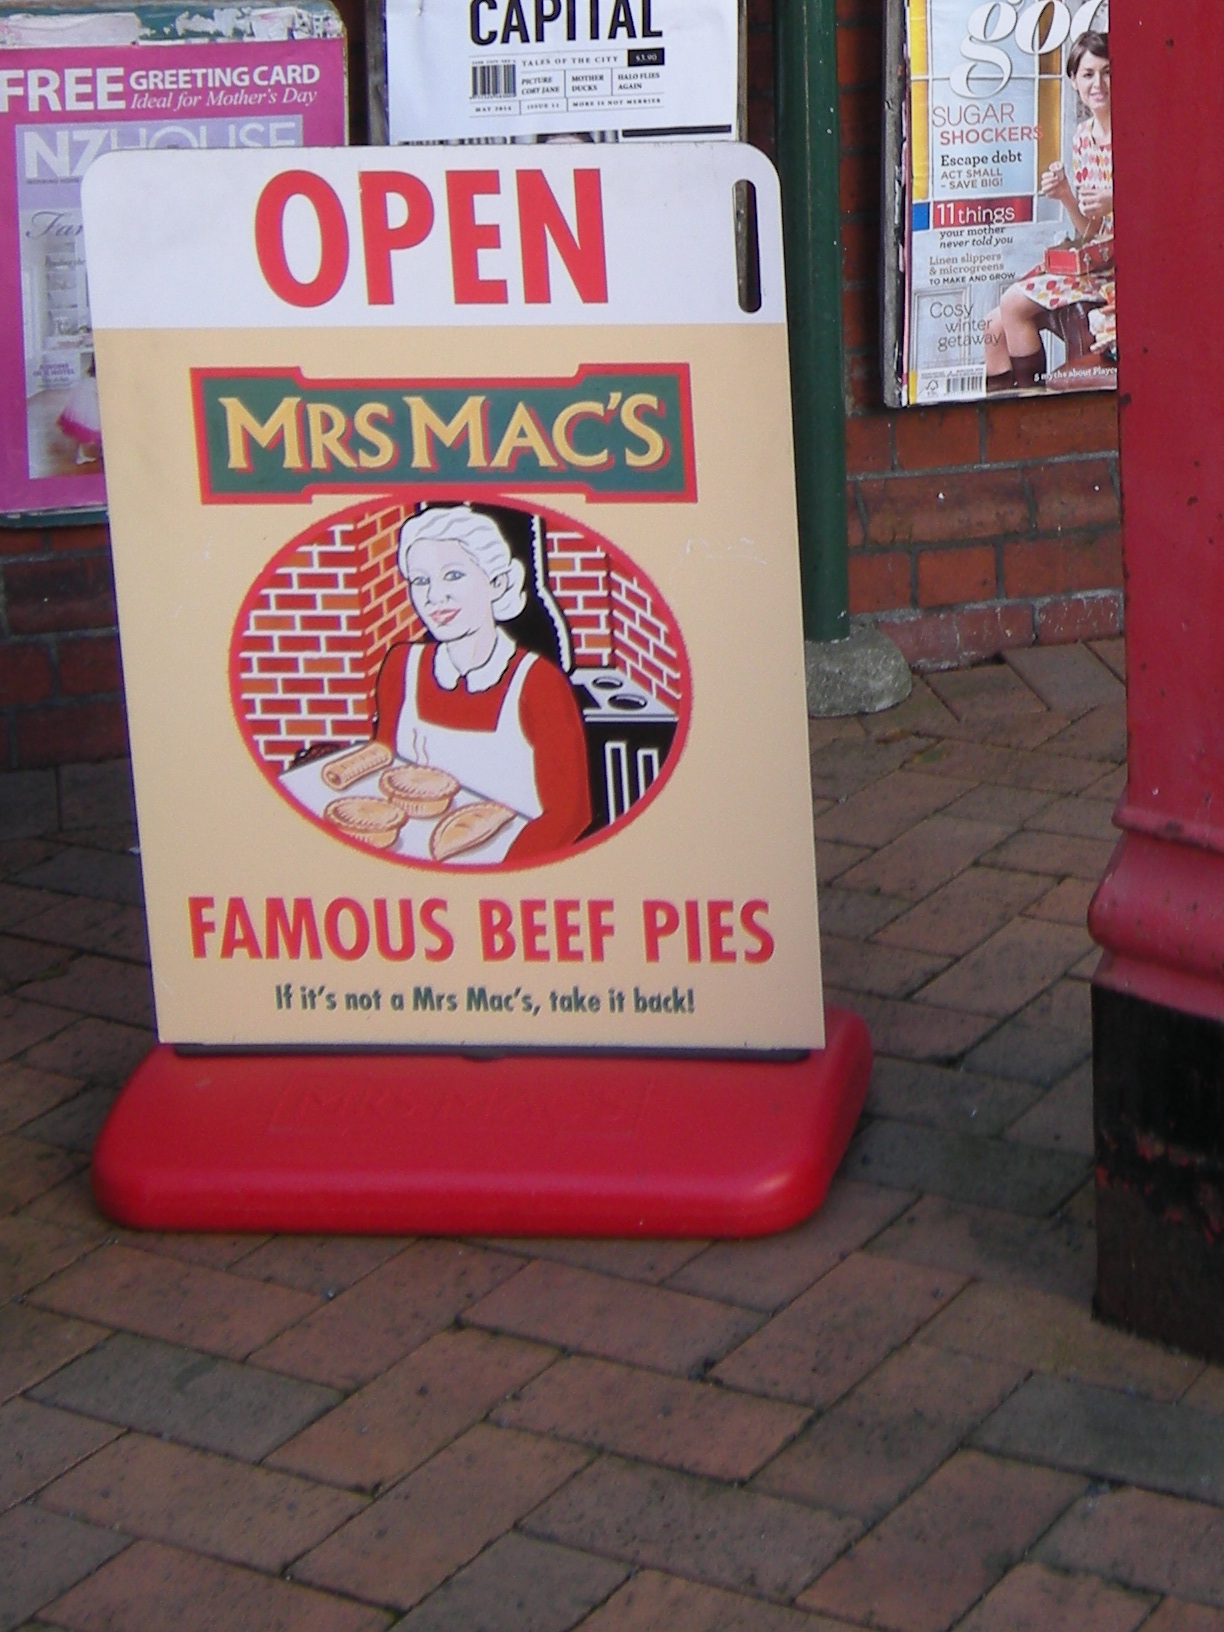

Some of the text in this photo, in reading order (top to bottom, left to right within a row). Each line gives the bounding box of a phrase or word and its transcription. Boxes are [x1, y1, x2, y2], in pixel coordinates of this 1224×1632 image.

[522, 57, 550, 67] TALES
[554, 56, 568, 65] OF
[572, 56, 591, 64] THE
[595, 55, 619, 63] CITY
[129, 63, 320, 90] GREETING CARD
[521, 76, 553, 86] PICTURE
[571, 74, 604, 82] MOTHER
[617, 71, 661, 80] HALO FLIES
[0, 66, 126, 113] FREE
[541, 85, 560, 94] JANE
[571, 84, 598, 92] DUCKS
[617, 82, 643, 90] AGAIN
[130, 88, 318, 112] Ideal for Mother's Day
[932, 102, 1015, 128] SUGAR
[940, 125, 1043, 146] SHOCKERS
[940, 151, 1022, 168] Escape debt
[940, 167, 1003, 180] ACT SMALL
[949, 177, 1003, 190] SAVE BIG!
[957, 205, 1016, 225] things
[254, 168, 609, 308] OPEN
[940, 225, 1006, 240] your mother
[940, 235, 1014, 249] never told you
[929, 253, 1001, 266] Linen slippers
[928, 262, 1004, 276] & microgreens
[929, 271, 1016, 286] TO MAKE AND GROW
[929, 301, 974, 320] Cosy
[945, 318, 993, 333] winter
[937, 331, 1001, 353] getaway
[187, 896, 775, 964] FAMOUS BEEF PIES
[275, 984, 695, 1017] If it's not a Mrs Mac's, take it back!
